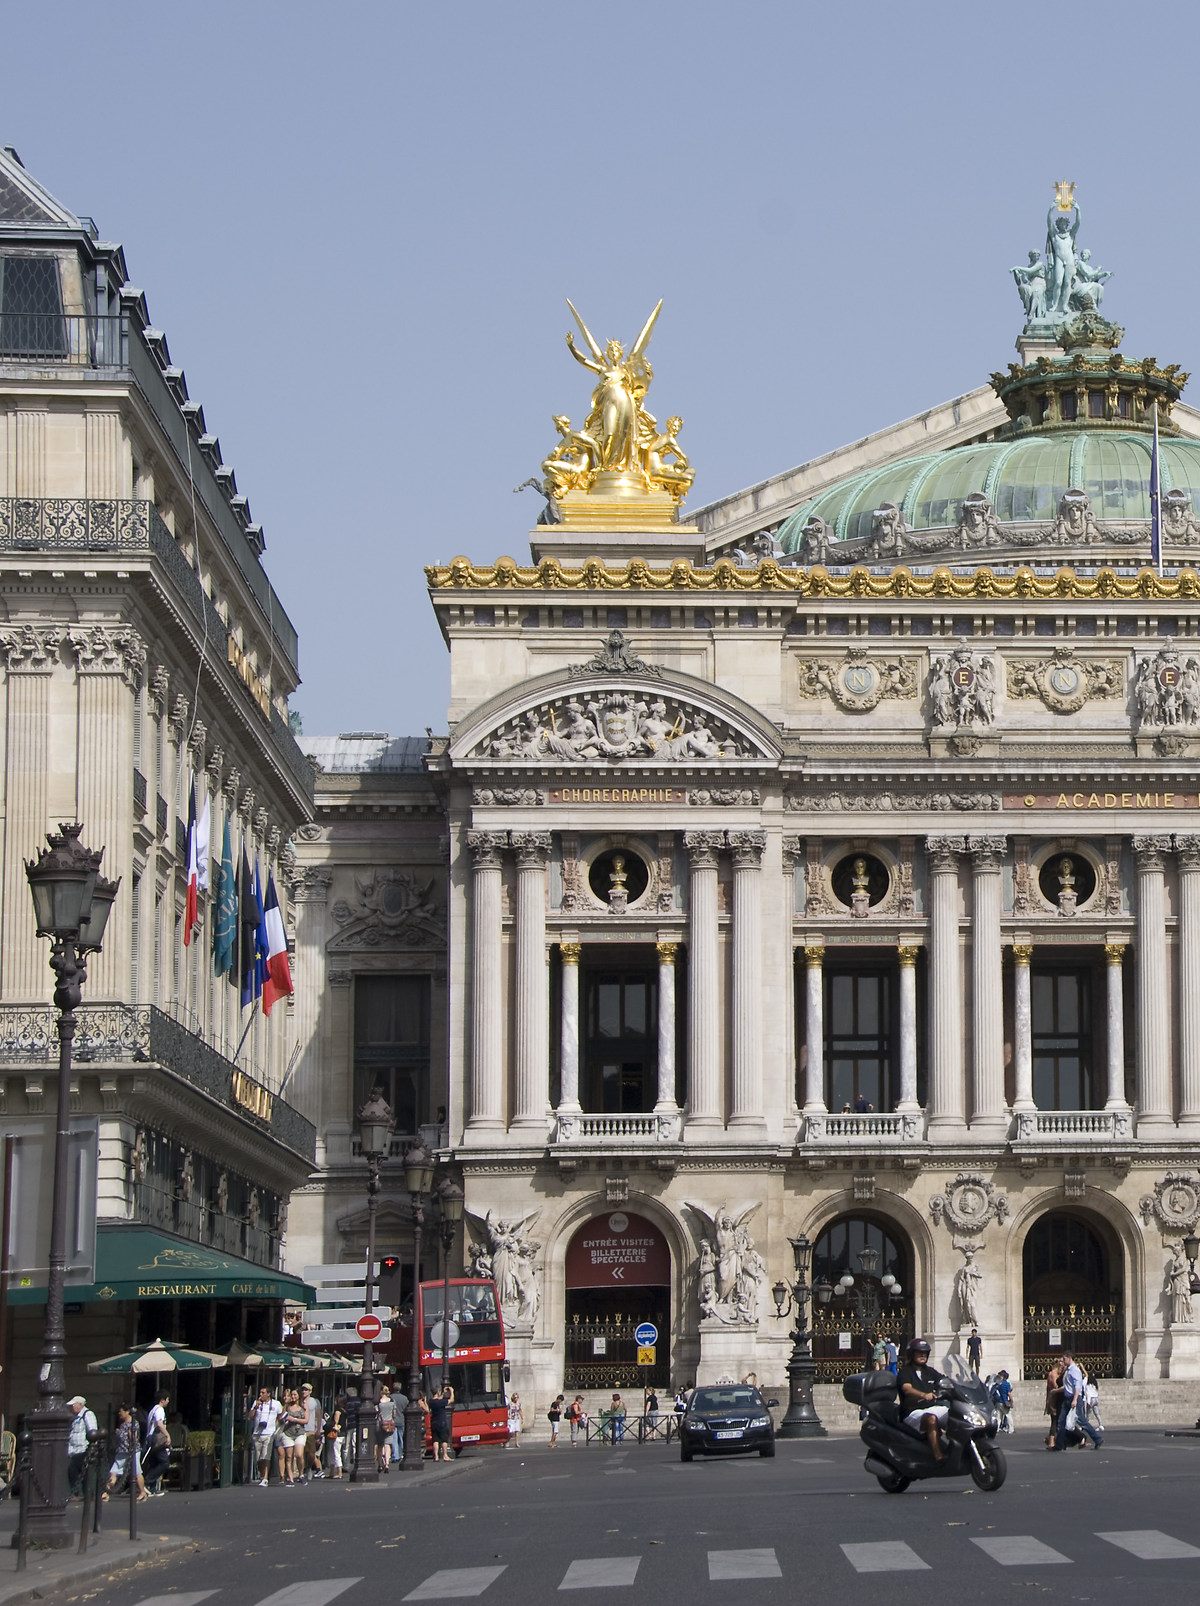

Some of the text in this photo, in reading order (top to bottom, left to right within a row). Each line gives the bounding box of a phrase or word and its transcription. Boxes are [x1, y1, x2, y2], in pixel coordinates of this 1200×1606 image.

[853, 673, 864, 687] N
[960, 672, 968, 683] E
[1060, 673, 1071, 687] N
[1165, 672, 1175, 683] E
[562, 788, 672, 802] CHOREGRAPHIE
[1056, 793, 1175, 808] ACADEMIE
[583, 1237, 655, 1248] ENTRÉE VISITES
[591, 1248, 647, 1257] BILLETTERIE
[591, 1255, 647, 1265] SPECTACLES
[138, 1284, 216, 1296] RESTAURANT
[232, 1282, 253, 1294] CAFÉ
